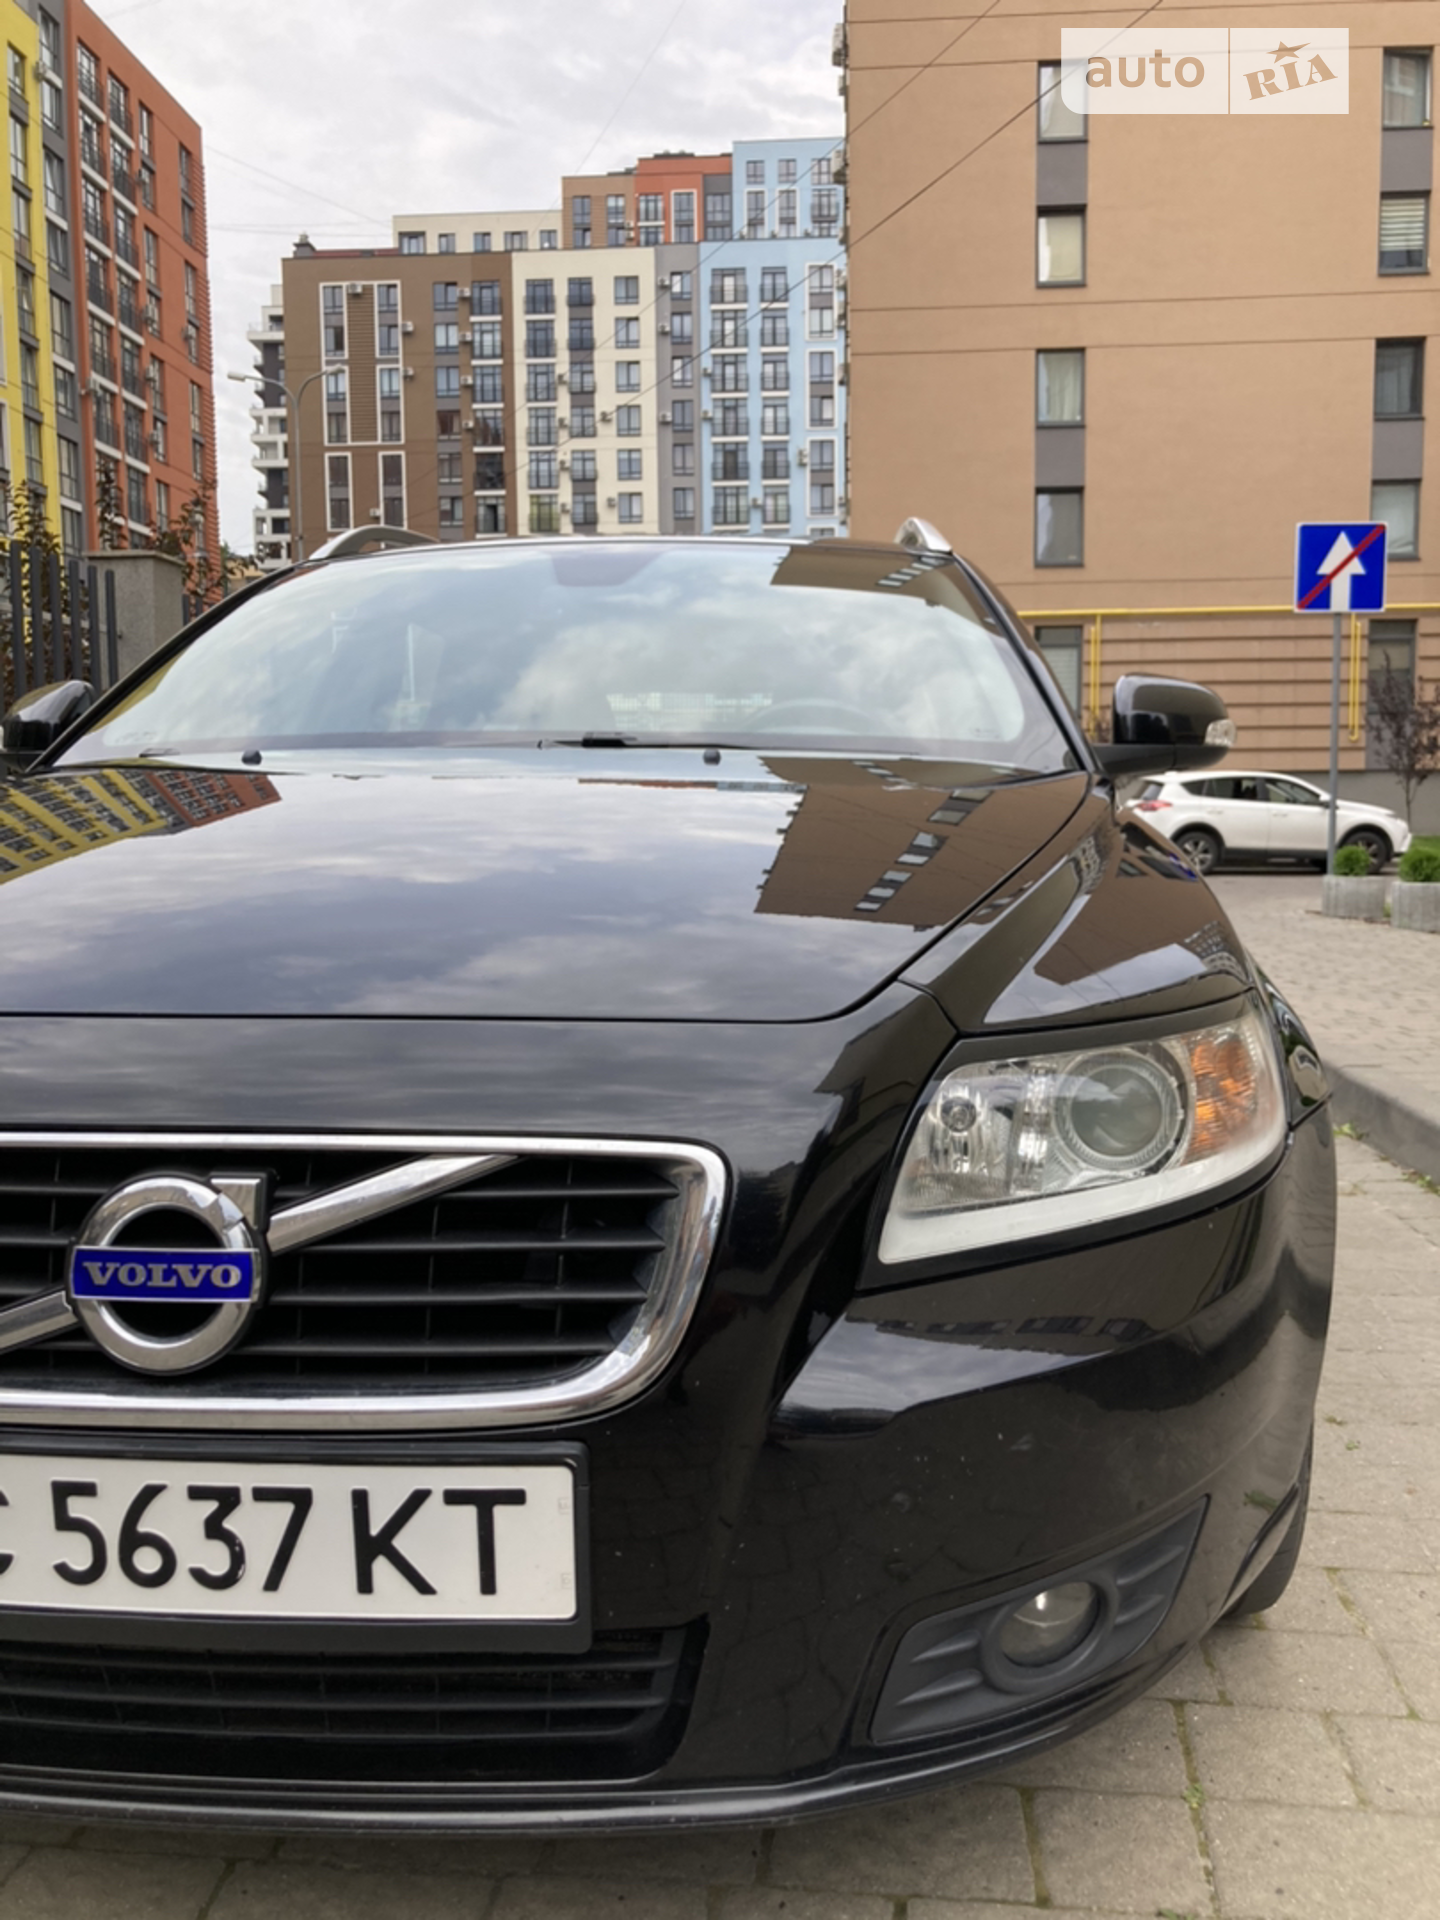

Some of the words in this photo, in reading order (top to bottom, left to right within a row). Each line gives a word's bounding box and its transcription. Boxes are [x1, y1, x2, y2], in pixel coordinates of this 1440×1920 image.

[83, 1261, 242, 1289] VOLVO
[51, 1480, 313, 1588] 5637
[351, 1488, 527, 1596] KT
